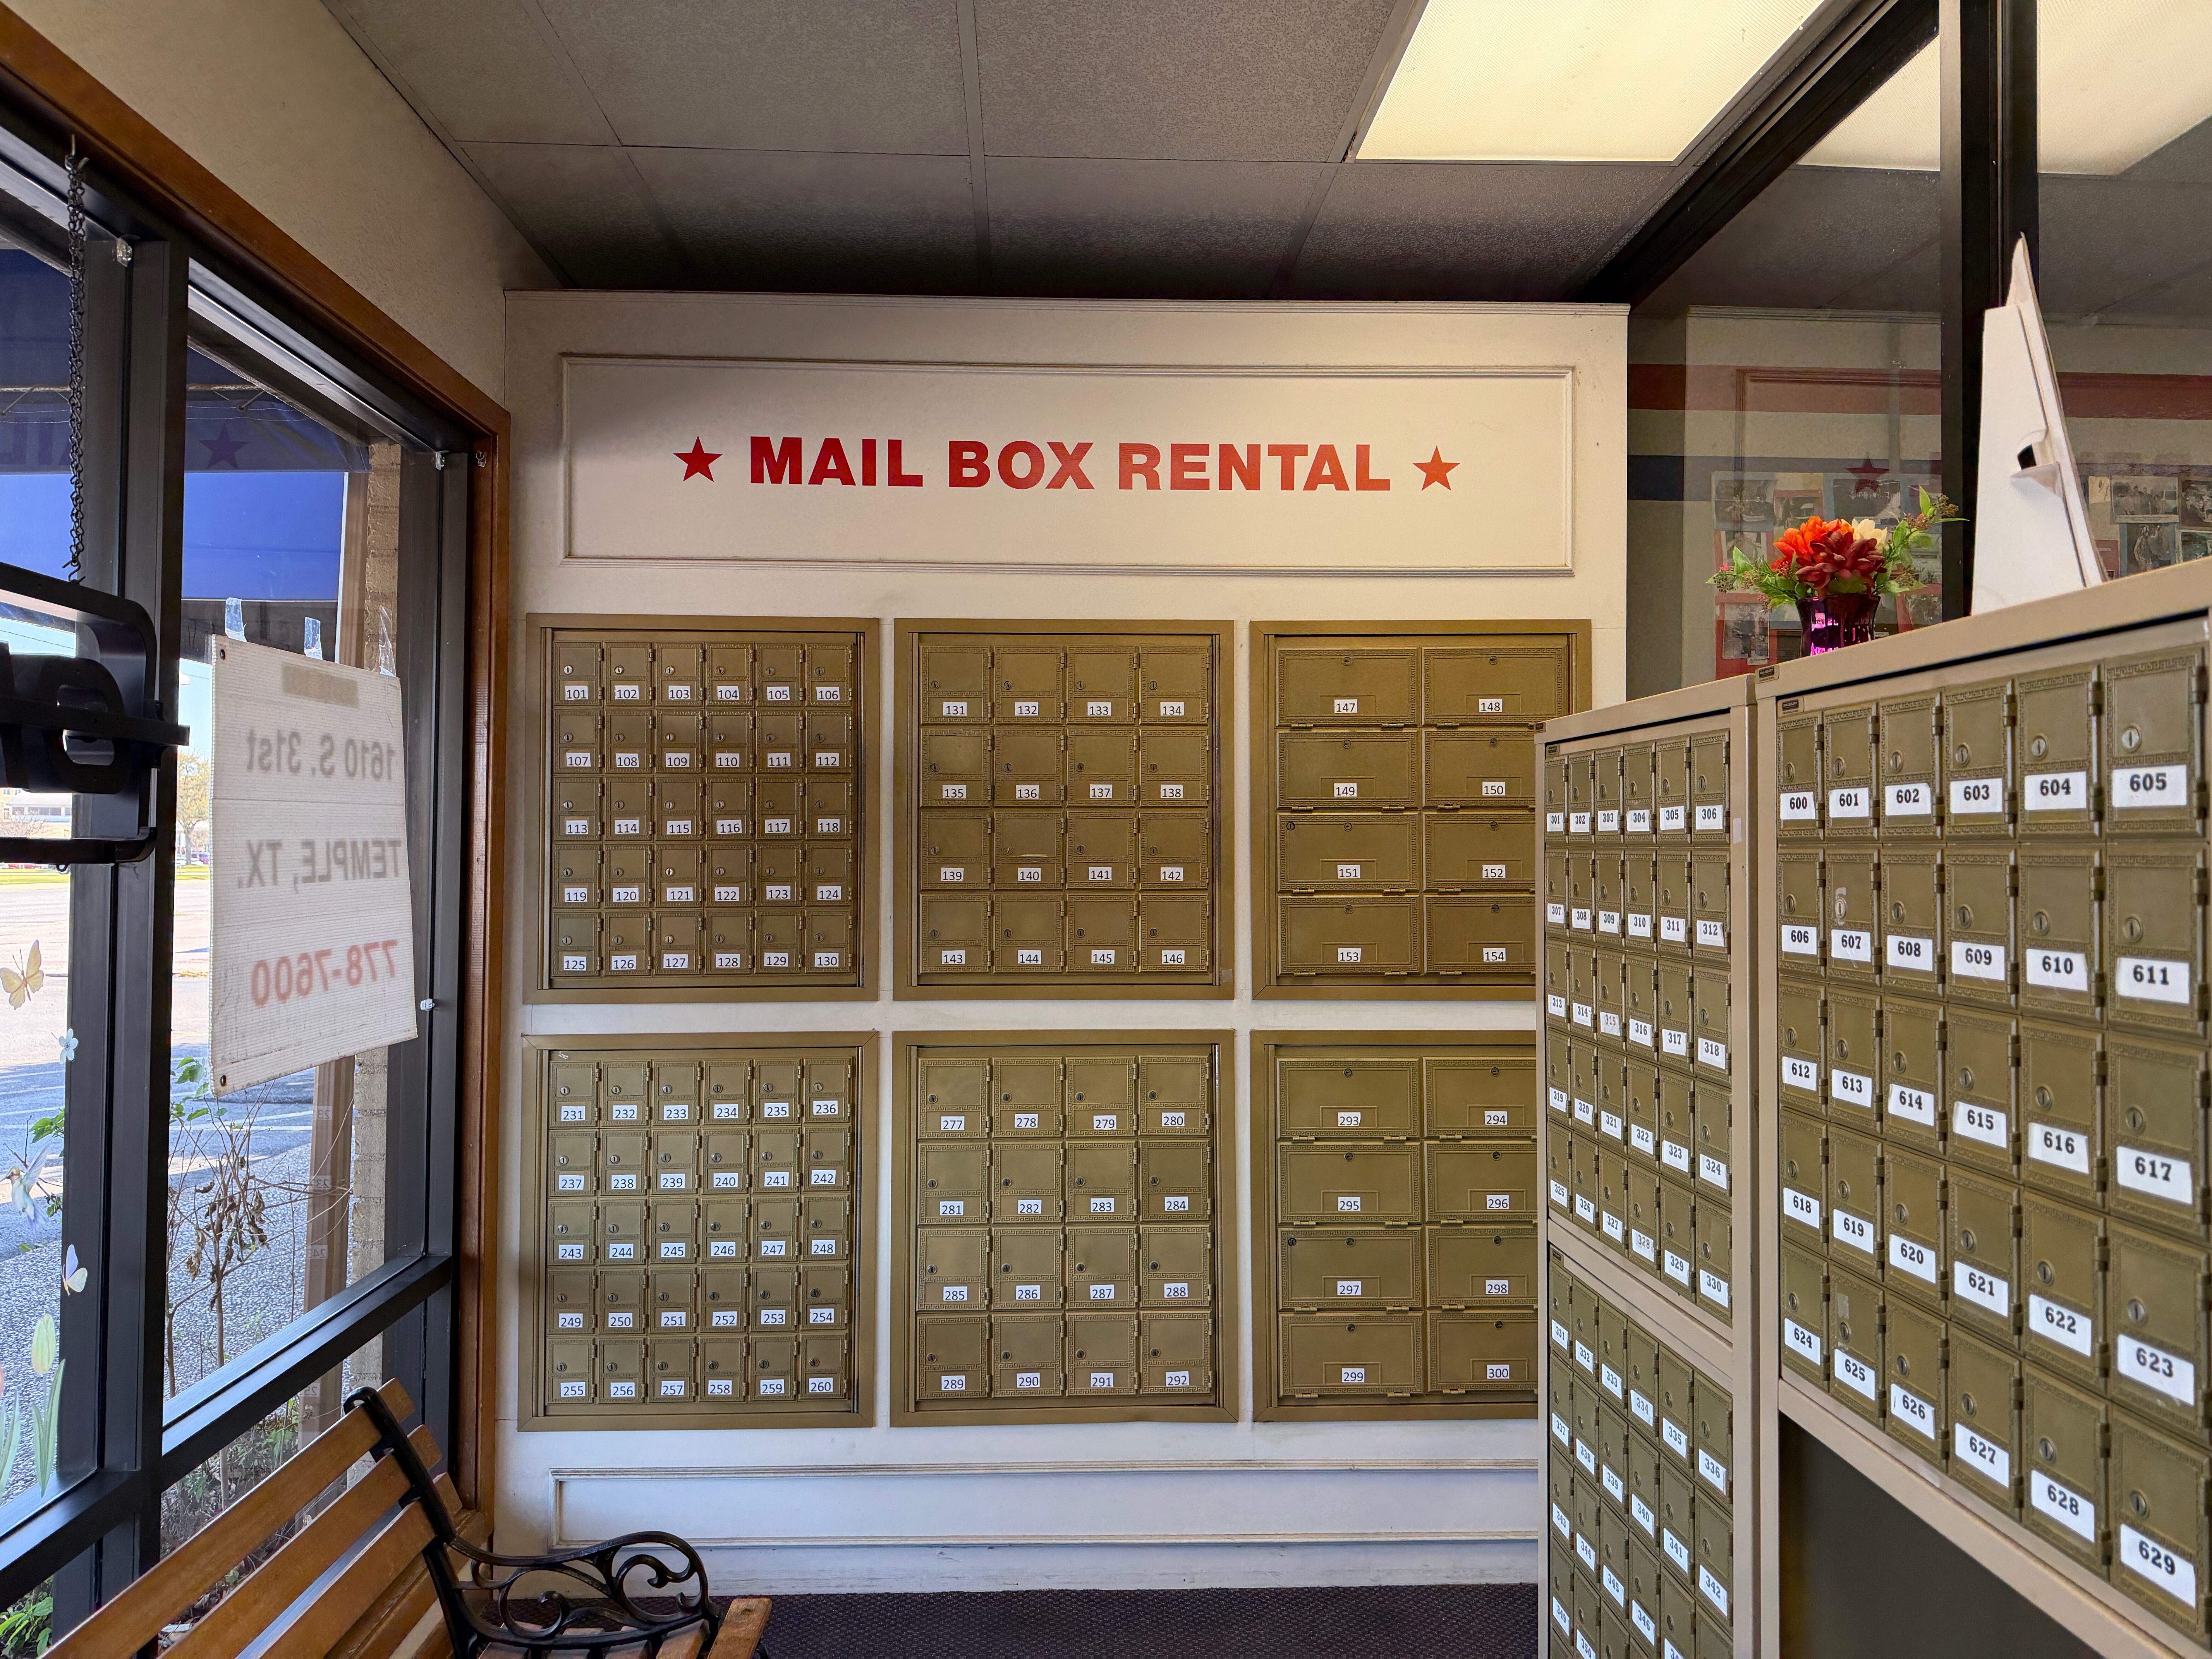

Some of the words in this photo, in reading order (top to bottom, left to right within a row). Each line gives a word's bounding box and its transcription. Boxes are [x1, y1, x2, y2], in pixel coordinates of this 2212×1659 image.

[750, 436, 923, 487] MAIL
[949, 440, 1093, 489] BOX
[1119, 443, 1390, 491] RENTAL
[567, 689, 587, 699] 101
[617, 689, 637, 699] 102
[670, 689, 689, 699] 103
[718, 690, 738, 699] 104
[769, 690, 788, 699] 105
[819, 690, 838, 700] 106
[946, 706, 965, 715] 131
[1018, 705, 1037, 714] 132
[1090, 706, 1109, 715] 133
[1163, 706, 1182, 715] 134
[1336, 703, 1355, 712] 147
[1481, 702, 1500, 711] 148
[2040, 778, 2071, 796] 604
[2130, 773, 2167, 792] 605
[945, 788, 963, 798] 135
[1018, 789, 1037, 798] 136
[1091, 788, 1110, 797] 137
[1162, 788, 1181, 797] 138
[1336, 787, 1355, 796] 149
[1484, 785, 1503, 795] 150
[1963, 784, 1990, 801] 603
[1839, 793, 1858, 807] 601
[1896, 788, 1919, 804] 602
[1790, 796, 1807, 810] 600
[1602, 812, 1614, 823] 303
[1633, 812, 1645, 823] 304
[1666, 809, 1679, 821] 305
[1702, 808, 1717, 820] 306
[1551, 815, 1560, 824] 301
[1575, 815, 1585, 824] 302
[567, 824, 587, 834] 113
[617, 823, 637, 833] 114
[670, 824, 689, 834] 115
[720, 823, 740, 833] 116
[768, 823, 788, 832] 117
[819, 823, 838, 832] 118
[943, 871, 962, 881] 139
[1020, 871, 1039, 880] 140
[1091, 870, 1110, 879] 141
[1162, 871, 1181, 880] 142
[1339, 868, 1358, 878] 151
[1484, 869, 1503, 878] 152
[1552, 906, 1561, 915] 307
[1577, 911, 1587, 921] 308
[1604, 913, 1614, 924] 309
[1634, 916, 1646, 927] 310
[1667, 919, 1680, 932] 311
[1703, 923, 1718, 936] 312
[1791, 930, 1809, 943] 606
[1841, 934, 1861, 949] 607
[1898, 941, 1921, 957] 608
[766, 956, 787, 966] 129
[944, 954, 963, 964] 143
[1020, 954, 1039, 963] 144
[1093, 953, 1112, 963] 145
[1163, 954, 1183, 963] 146
[1340, 952, 1359, 961] 153
[1485, 951, 1504, 961] 154
[1965, 948, 1992, 965] 609
[565, 960, 585, 970] 125
[614, 959, 634, 969] 126
[666, 958, 686, 967] 127
[718, 957, 738, 967] 128
[817, 957, 837, 966] 130
[2042, 955, 2073, 974] 610
[2133, 965, 2169, 985] 611
[1635, 1022, 1647, 1036] 316
[1668, 1032, 1681, 1045] 317
[1704, 1041, 1719, 1056] 318
[1791, 1062, 1810, 1079] 612
[1842, 1076, 1862, 1093] 613
[1899, 1091, 1922, 1110] 614
[615, 1109, 635, 1119] 232
[666, 1109, 686, 1119] 233
[717, 1108, 737, 1118] 234
[767, 1106, 787, 1116] 235
[816, 1104, 836, 1114] 236
[563, 1110, 583, 1120] 231
[1486, 1115, 1506, 1124] 294
[1967, 1109, 1994, 1130] 615
[943, 1120, 963, 1130] 277
[1017, 1118, 1036, 1127] 278
[1096, 1119, 1115, 1128] 279
[1164, 1116, 1183, 1125] 280
[1340, 1116, 1359, 1126] 293
[1606, 1115, 1617, 1128] 321
[1637, 1128, 1649, 1143] 322
[2044, 1131, 2075, 1154] 616
[1669, 1144, 1682, 1159] 323
[1706, 1159, 1721, 1176] 324
[2135, 1156, 2171, 1182] 617
[1020, 1204, 1039, 1213] 282
[1092, 1202, 1112, 1212] 283
[1166, 1200, 1186, 1210] 284
[1340, 1200, 1359, 1210] 295
[1488, 1199, 1508, 1209] 296
[1793, 1195, 1811, 1214] 618
[942, 1205, 961, 1214] 281
[1607, 1215, 1618, 1230] 327
[1844, 1217, 1864, 1237] 619
[561, 1249, 581, 1258] 243
[611, 1247, 632, 1257] 244
[664, 1247, 684, 1256] 245
[714, 1245, 734, 1255] 246
[763, 1245, 783, 1255] 247
[813, 1244, 833, 1254] 248
[1901, 1243, 1924, 1264] 620
[1670, 1255, 1684, 1272] 329
[1487, 1284, 1507, 1293] 298
[1707, 1275, 1721, 1293] 330
[1968, 1272, 1994, 1297] 621
[945, 1290, 965, 1300] 285
[1018, 1289, 1038, 1299] 286
[1092, 1288, 1112, 1298] 287
[1166, 1287, 1186, 1297] 288
[1340, 1285, 1359, 1295] 297
[2045, 1306, 2076, 1334] 622
[1794, 1327, 1812, 1349] 624
[2136, 1347, 2173, 1378] 623
[1489, 1368, 1508, 1378] 300
[1845, 1358, 1865, 1381] 625
[1019, 1376, 1039, 1386] 290
[1092, 1377, 1111, 1387] 291
[1168, 1375, 1187, 1386] 292
[1344, 1372, 1363, 1382] 299
[1606, 1370, 1618, 1388] 333
[811, 1382, 831, 1392] 260
[944, 1379, 963, 1389] 289
[1637, 1397, 1649, 1415] 334
[1902, 1395, 1925, 1419] 626
[1669, 1426, 1682, 1445] 335
[1970, 1436, 1996, 1464] 627
[1705, 1458, 1720, 1479] 336
[1607, 1472, 1618, 1490] 339
[2047, 1484, 2079, 1516] 628
[1637, 1503, 1649, 1522] 340
[1669, 1537, 1683, 1559] 341
[2139, 1540, 2175, 1575] 629
[1608, 1573, 1619, 1593] 345
[1706, 1575, 1721, 1599] 342
[1638, 1609, 1650, 1631] 346
